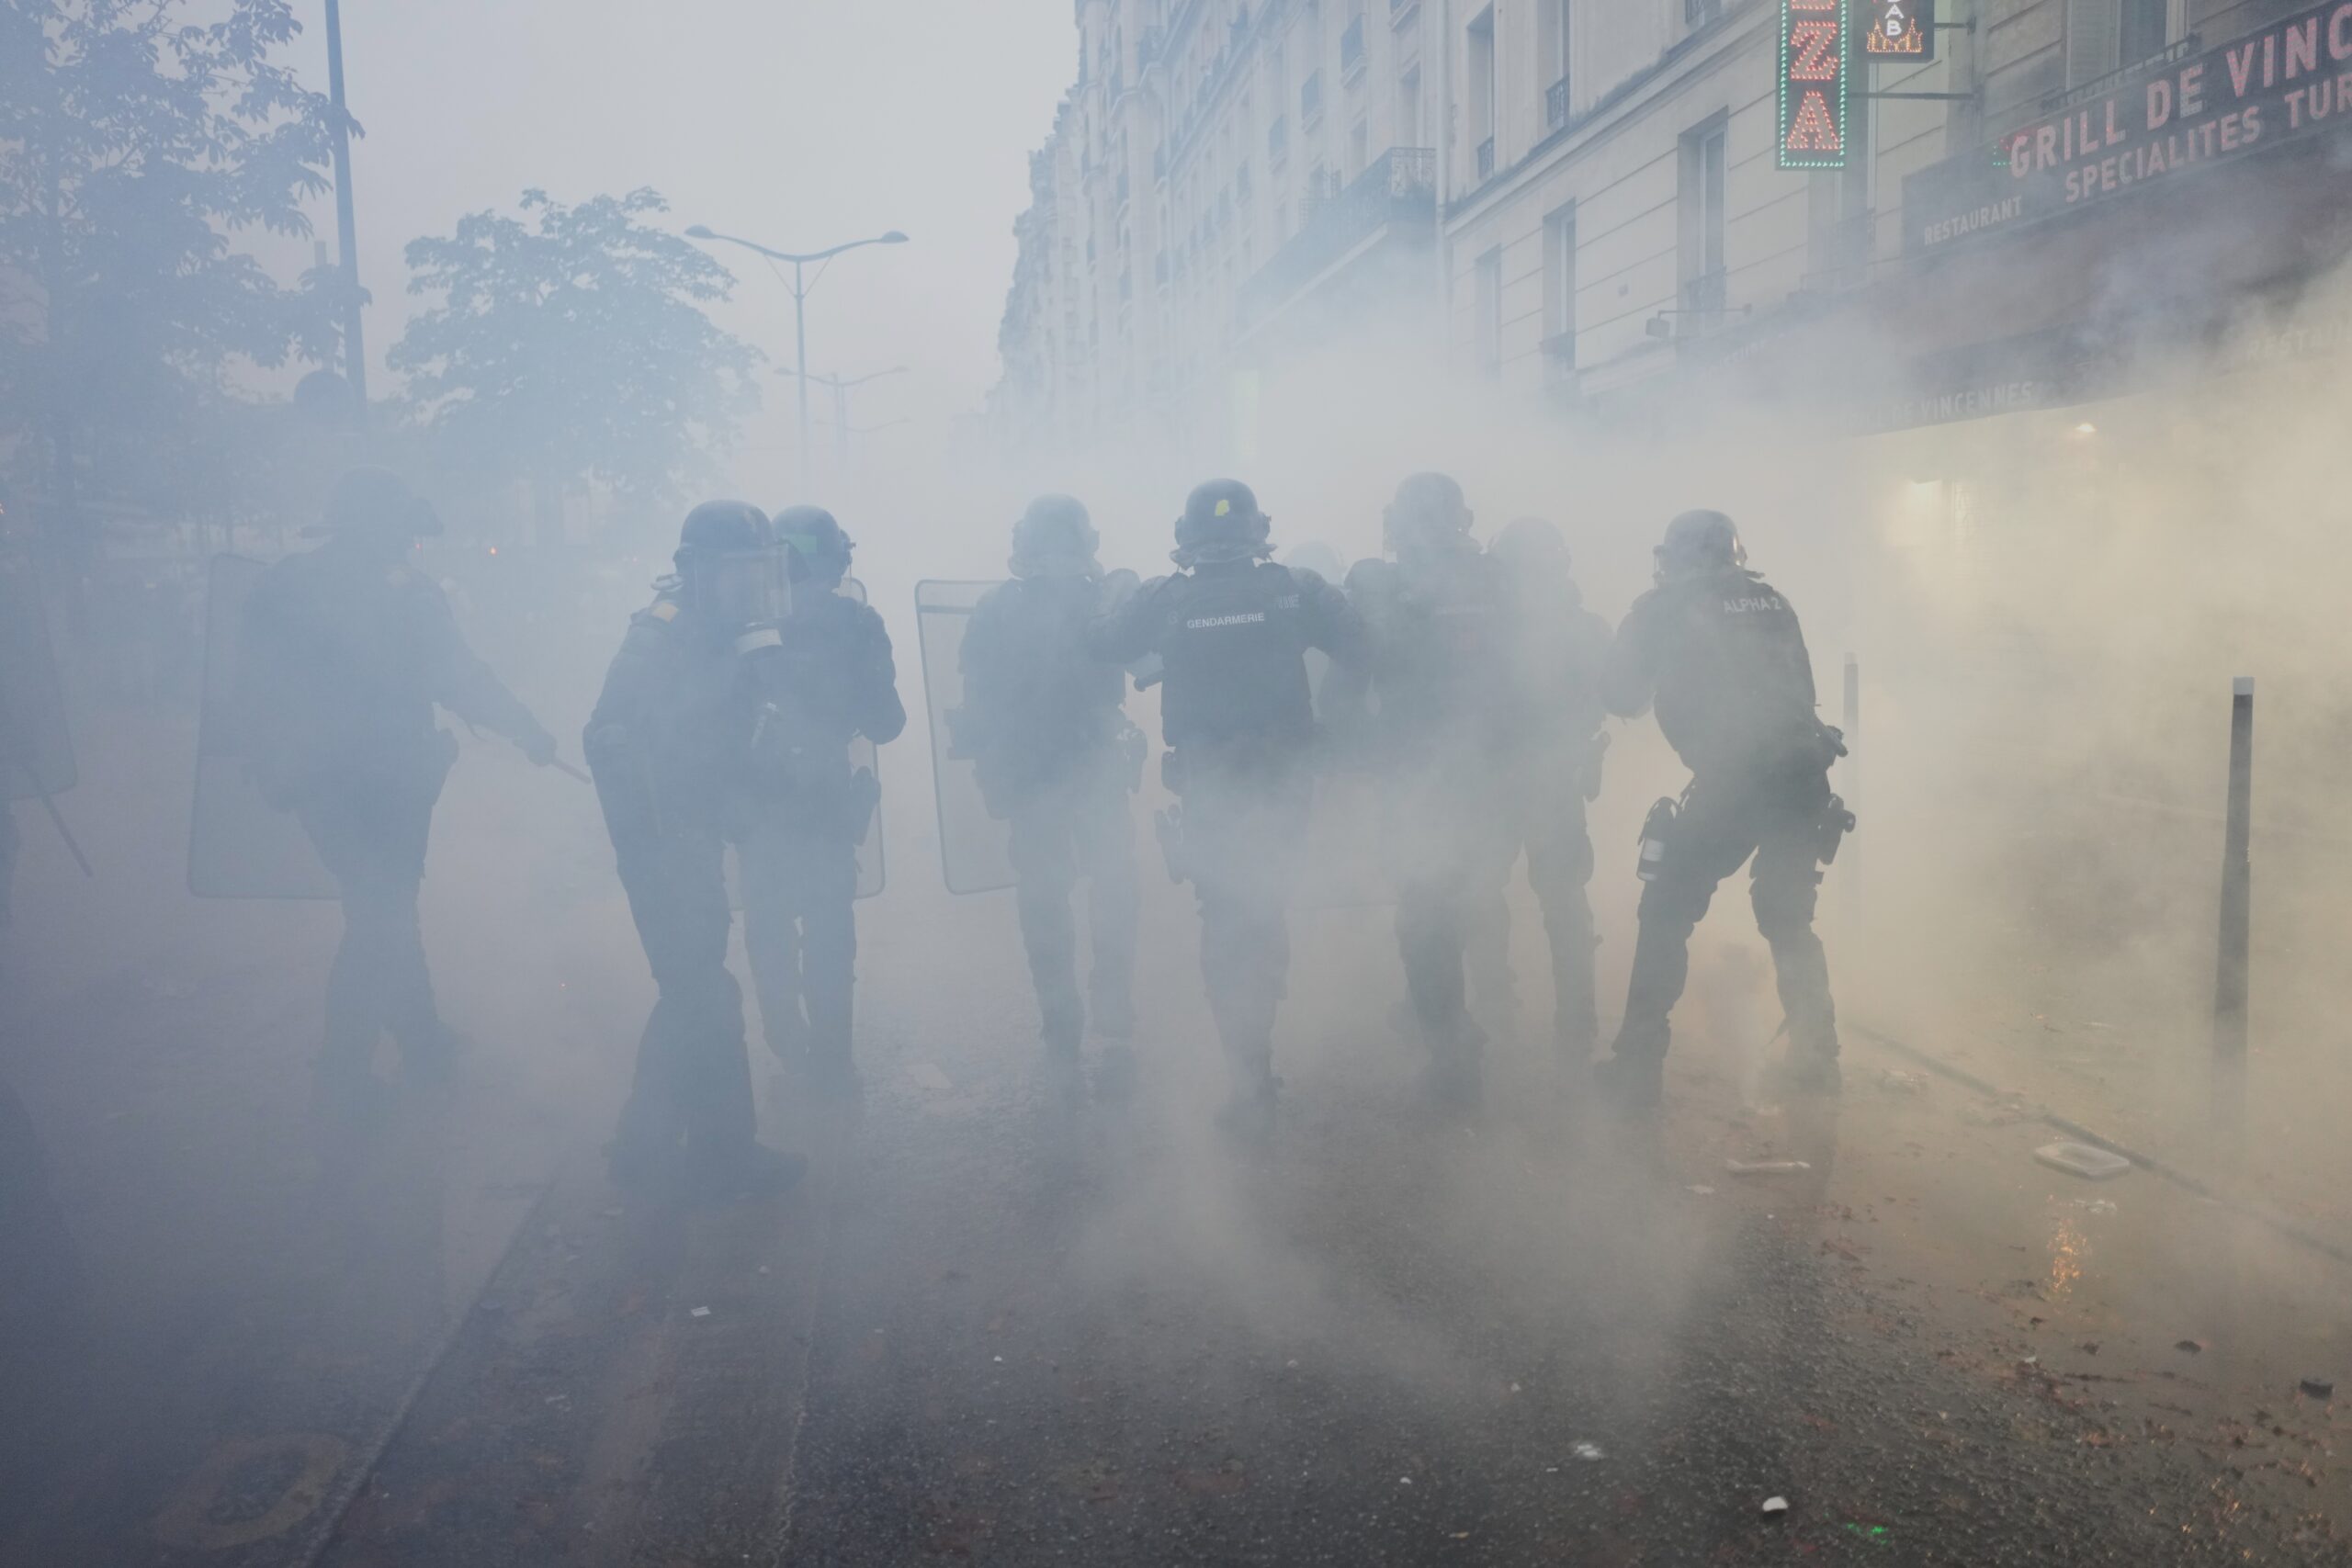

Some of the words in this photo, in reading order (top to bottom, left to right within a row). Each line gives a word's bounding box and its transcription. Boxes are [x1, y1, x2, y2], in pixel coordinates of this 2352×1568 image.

[1884, 0, 1905, 36] AB
[1788, 0, 1840, 150] ZA
[2011, 100, 2126, 178] GRILL
[2146, 62, 2203, 131] DE
[2065, 106, 2260, 203] SPECIALITES
[1925, 196, 2022, 245] RESTAURANT
[1920, 380, 2033, 421] VINCENNES
[1187, 612, 1265, 629] GENDARMERIE
[1724, 596, 1771, 614] ALPHA
[1770, 596, 1782, 610] 2
